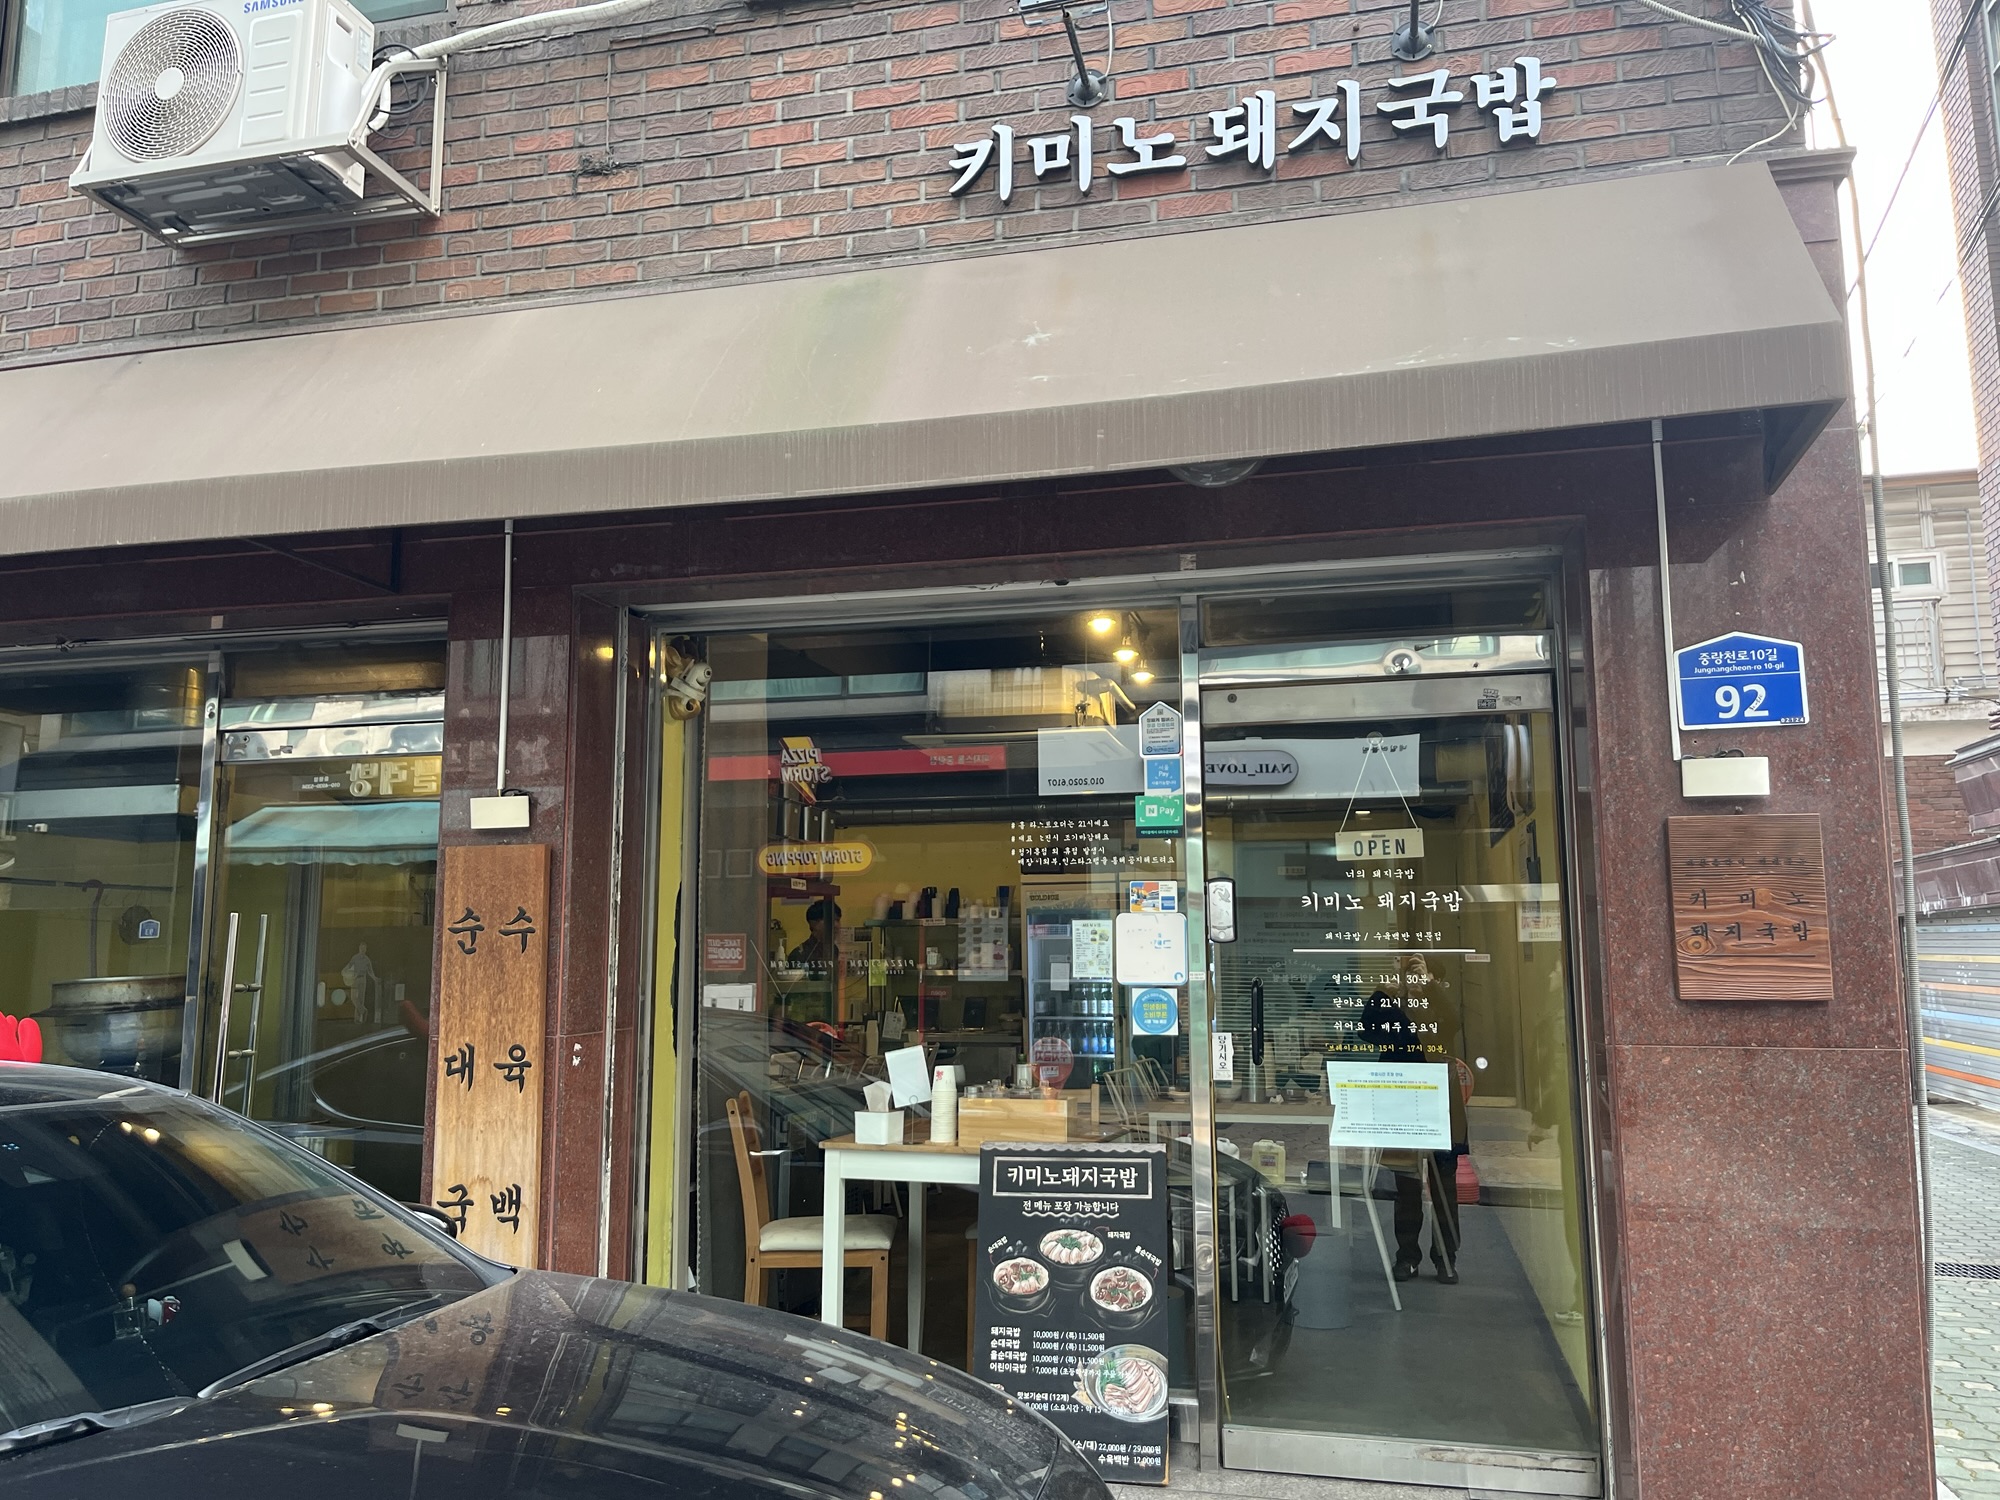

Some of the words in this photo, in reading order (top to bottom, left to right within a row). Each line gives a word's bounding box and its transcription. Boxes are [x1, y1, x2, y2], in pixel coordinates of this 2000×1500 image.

[243, 0, 305, 13] SAMSU
[1698, 648, 1777, 665] 중랑천로10길
[1694, 664, 1762, 674] Jungnangcheon-ro
[1764, 662, 1784, 671] 10-gil
[1715, 684, 1769, 719] 92
[1159, 806, 1175, 817] Pay
[1353, 838, 1406, 857] OPEN
[1128, 856, 1175, 865] 공지해드려요
[1345, 868, 1365, 879] 너의
[1372, 868, 1415, 880] 돼지국밥
[1301, 890, 1364, 912] 키미노
[1377, 890, 1463, 912] 돼지국밥
[1325, 931, 1362, 941] 돼지국밥
[1373, 931, 1410, 941] 수육백반
[1415, 931, 1442, 941] 전문점
[1331, 973, 1363, 984] 열어요
[1379, 973, 1400, 985] 11시
[1406, 973, 1430, 985] 30분
[1332, 997, 1364, 1008] 닫아요
[1380, 997, 1401, 1008] 21시
[1407, 997, 1430, 1008] 30분
[1333, 1021, 1365, 1032] 쉬어요
[1381, 1022, 1402, 1033] 매주
[1407, 1022, 1438, 1034] 금요일
[1217, 1035, 1228, 1069] 당기시오
[1379, 1044, 1395, 1053] 15시
[1406, 1044, 1423, 1053] 17시
[1007, 1165, 1138, 1189] 키미노돼지국밥
[1023, 1200, 1031, 1210] 전
[1034, 1201, 1051, 1211] 메뉴
[1054, 1201, 1072, 1212] 포장
[1075, 1201, 1120, 1213] 가능합니다
[1107, 1231, 1131, 1240] 돼지국밥
[987, 1236, 1009, 1254] 순대국밥
[990, 1327, 1021, 1337] 돼지국밥
[1032, 1330, 1059, 1340] 10,000원
[990, 1339, 1021, 1349] 순대국밥
[1032, 1341, 1059, 1350] 10,000원
[1032, 1354, 1059, 1364] 10,000원
[989, 1362, 1027, 1373] 어린이국밥
[1035, 1366, 1058, 1375] 7,000원
[1017, 1391, 1048, 1401] 맛보기순대
[1049, 1392, 1070, 1402] (12개)
[1050, 1403, 1080, 1413] (소요시간
[1098, 1443, 1126, 1453] 22,000원
[1097, 1455, 1130, 1466] 수육백반
[1133, 1455, 1161, 1466] 12,000원
